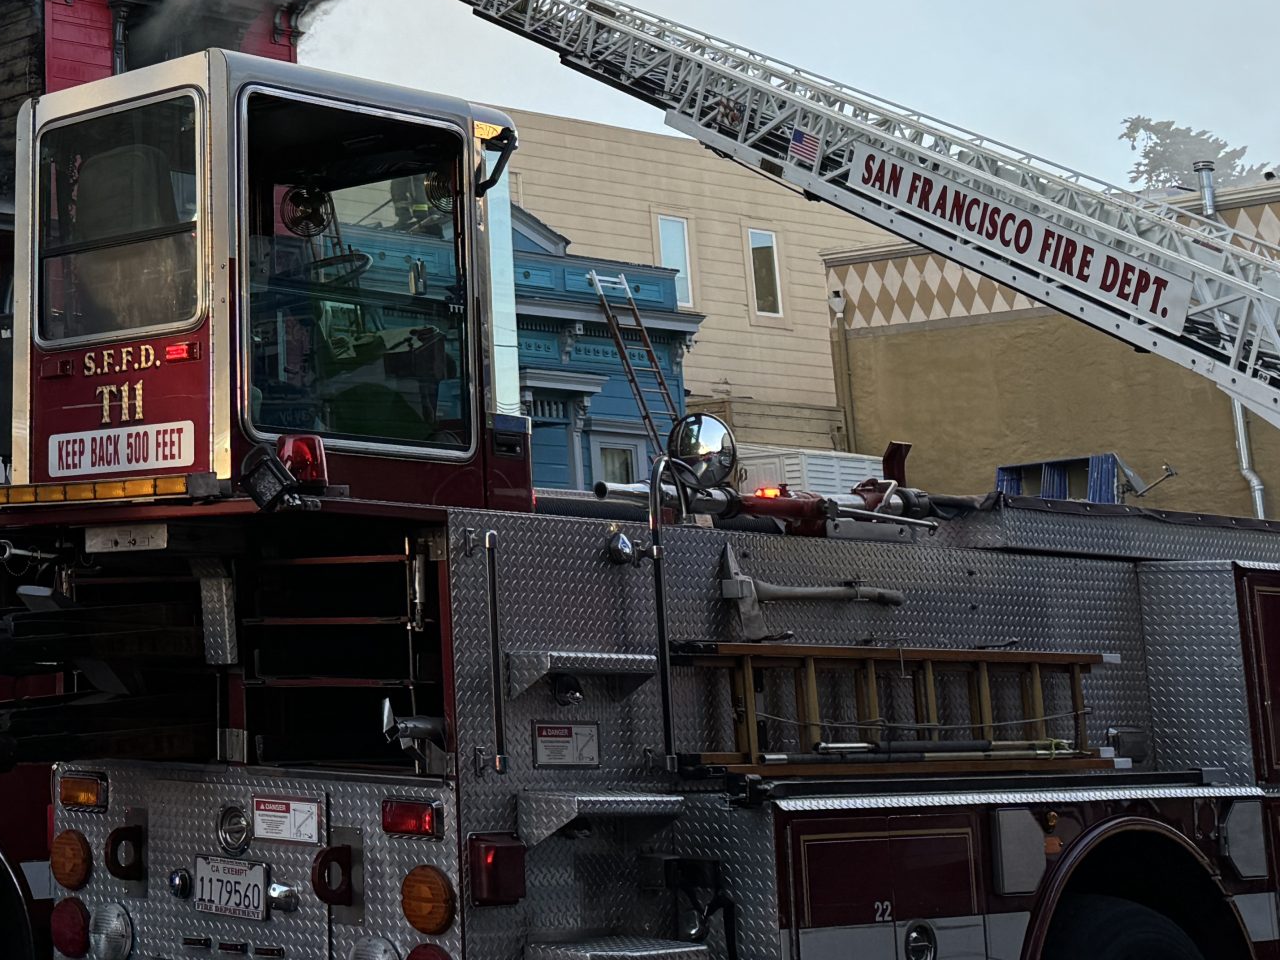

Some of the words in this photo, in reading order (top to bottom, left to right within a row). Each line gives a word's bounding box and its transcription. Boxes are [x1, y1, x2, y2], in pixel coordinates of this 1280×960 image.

[861, 153, 903, 198] SAN
[906, 172, 1034, 256] FRANCISCO
[1038, 228, 1095, 284] FIRE
[1099, 256, 1169, 319] DEPT.
[83, 345, 161, 376] S.F.F.D.
[96, 380, 144, 424] T11
[58, 438, 85, 471] KEEP
[90, 434, 121, 468] BACK
[126, 430, 149, 465] 500
[155, 427, 184, 461] FEET
[547, 728, 569, 736] DANGER
[265, 803, 286, 811] DANGER
[211, 865, 220, 874] CA
[223, 867, 248, 877] EXEMPT
[198, 876, 261, 910] 1179560
[197, 902, 214, 912] FIRE
[215, 905, 261, 919] DEPARTMENT
[874, 900, 892, 921] 22
